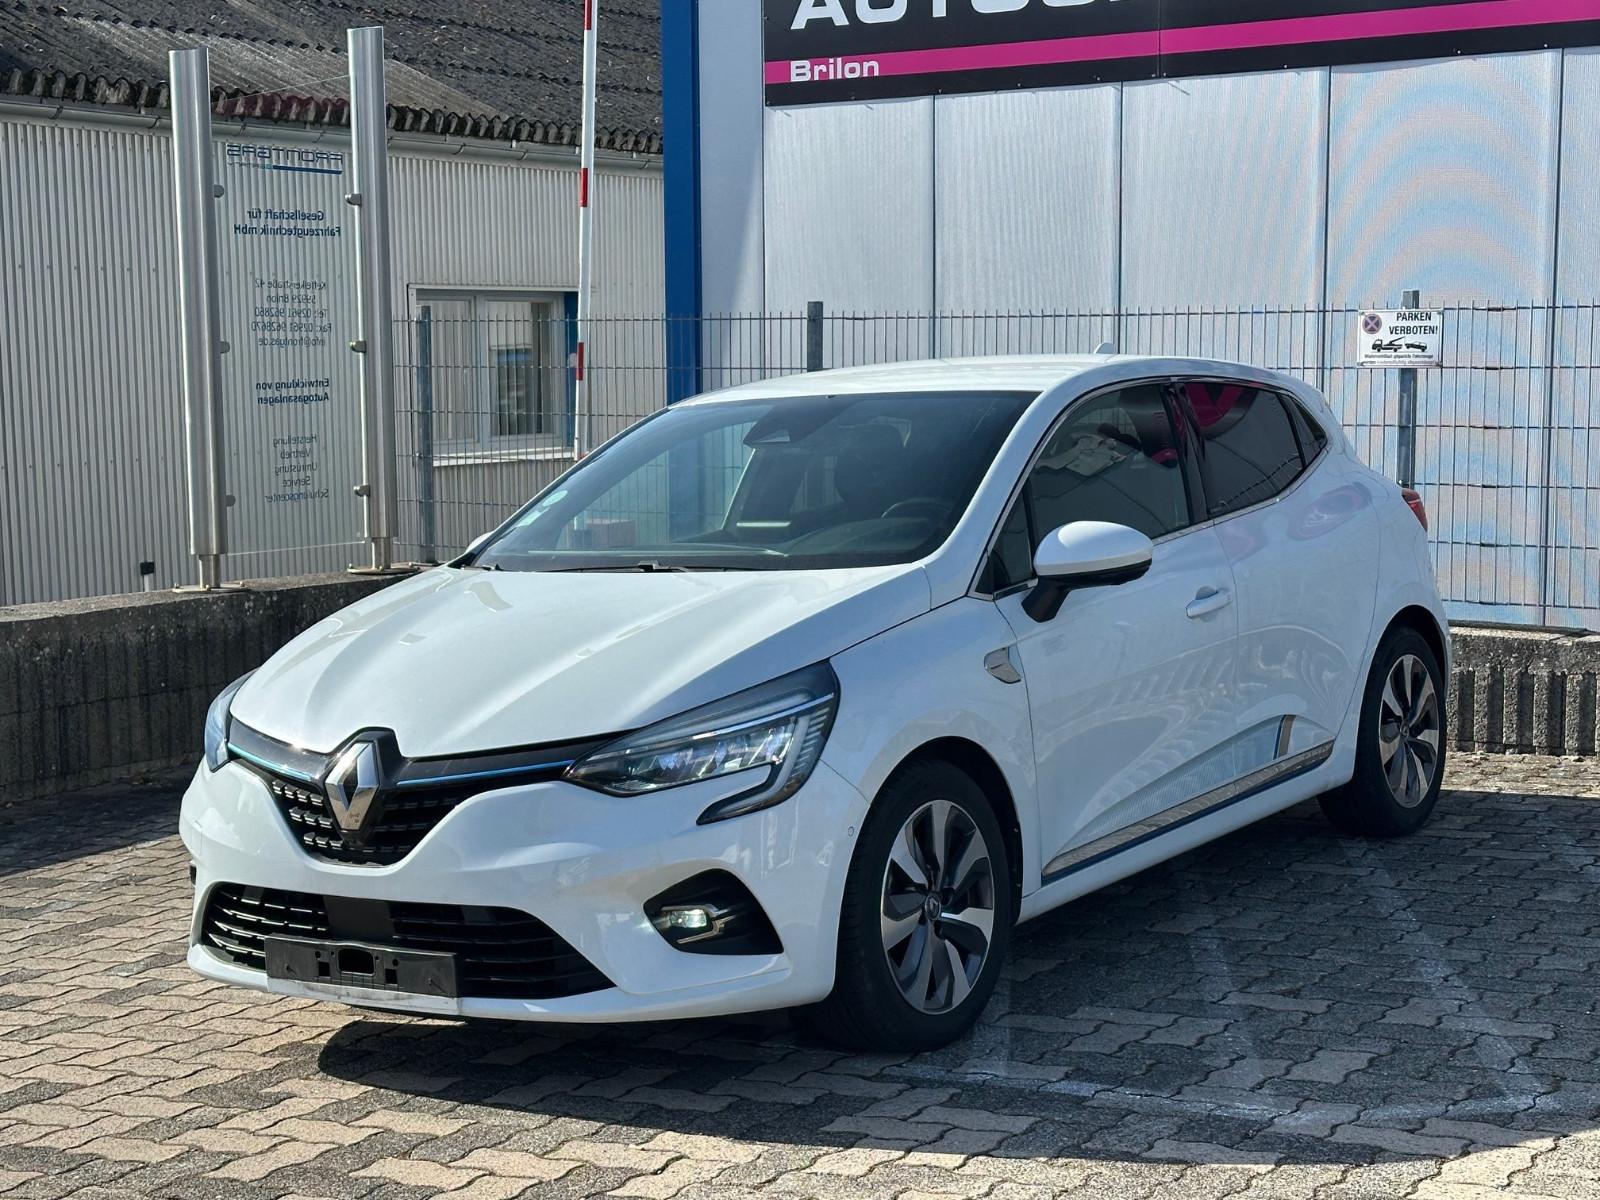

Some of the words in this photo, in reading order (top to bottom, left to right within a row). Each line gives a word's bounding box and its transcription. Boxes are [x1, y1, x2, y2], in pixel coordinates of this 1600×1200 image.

[790, 57, 879, 82] Brilon
[1396, 312, 1432, 321] PARKEN
[1389, 325, 1438, 335] VERBOTEN!
